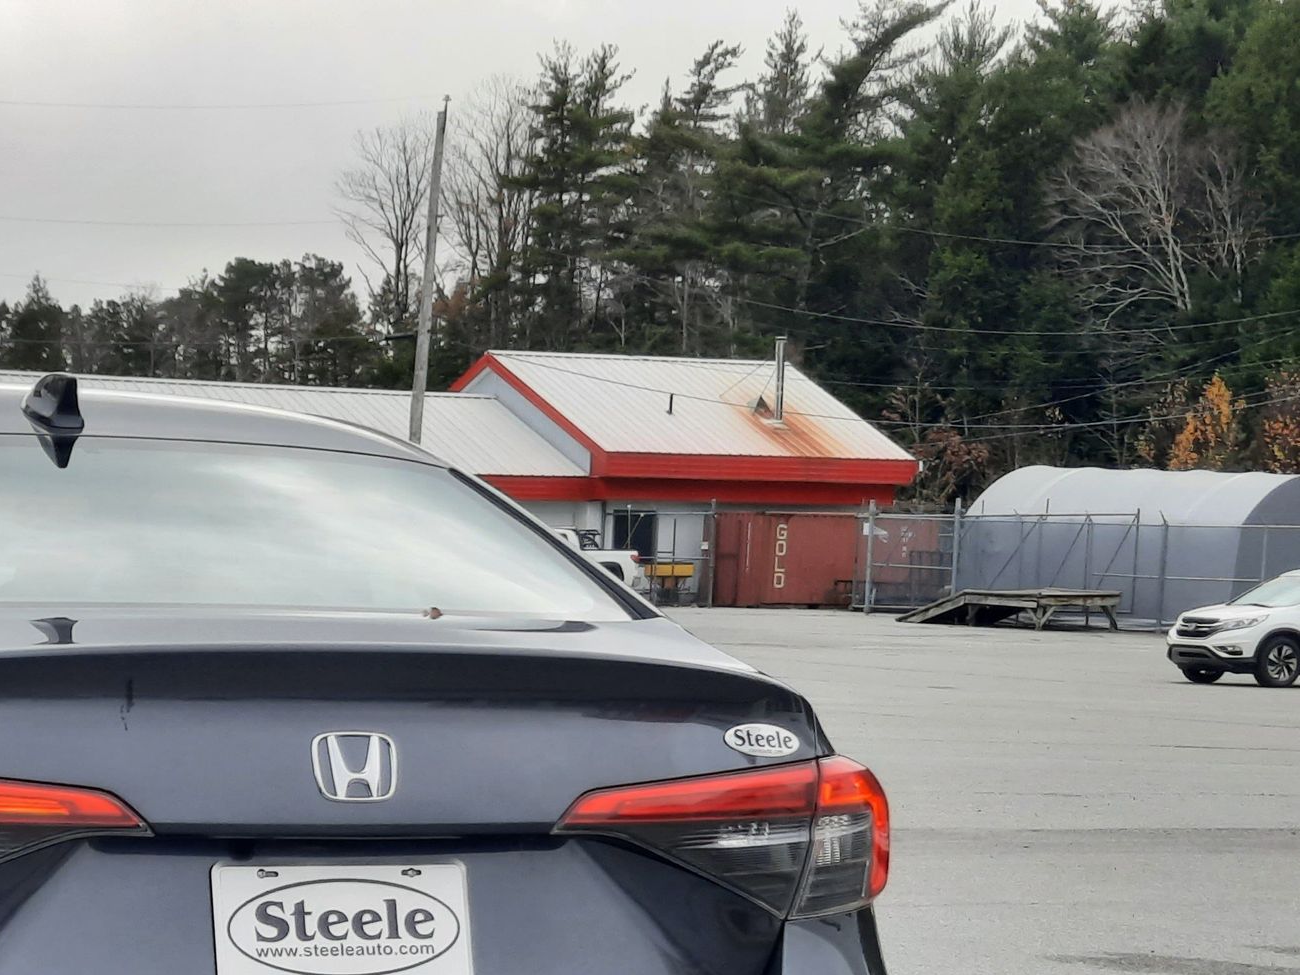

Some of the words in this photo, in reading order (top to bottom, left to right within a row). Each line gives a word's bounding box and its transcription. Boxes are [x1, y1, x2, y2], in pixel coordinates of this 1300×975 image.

[733, 728, 793, 749] Steele
[254, 898, 436, 943] Steele
[256, 942, 435, 957] www.steeleauto.com
